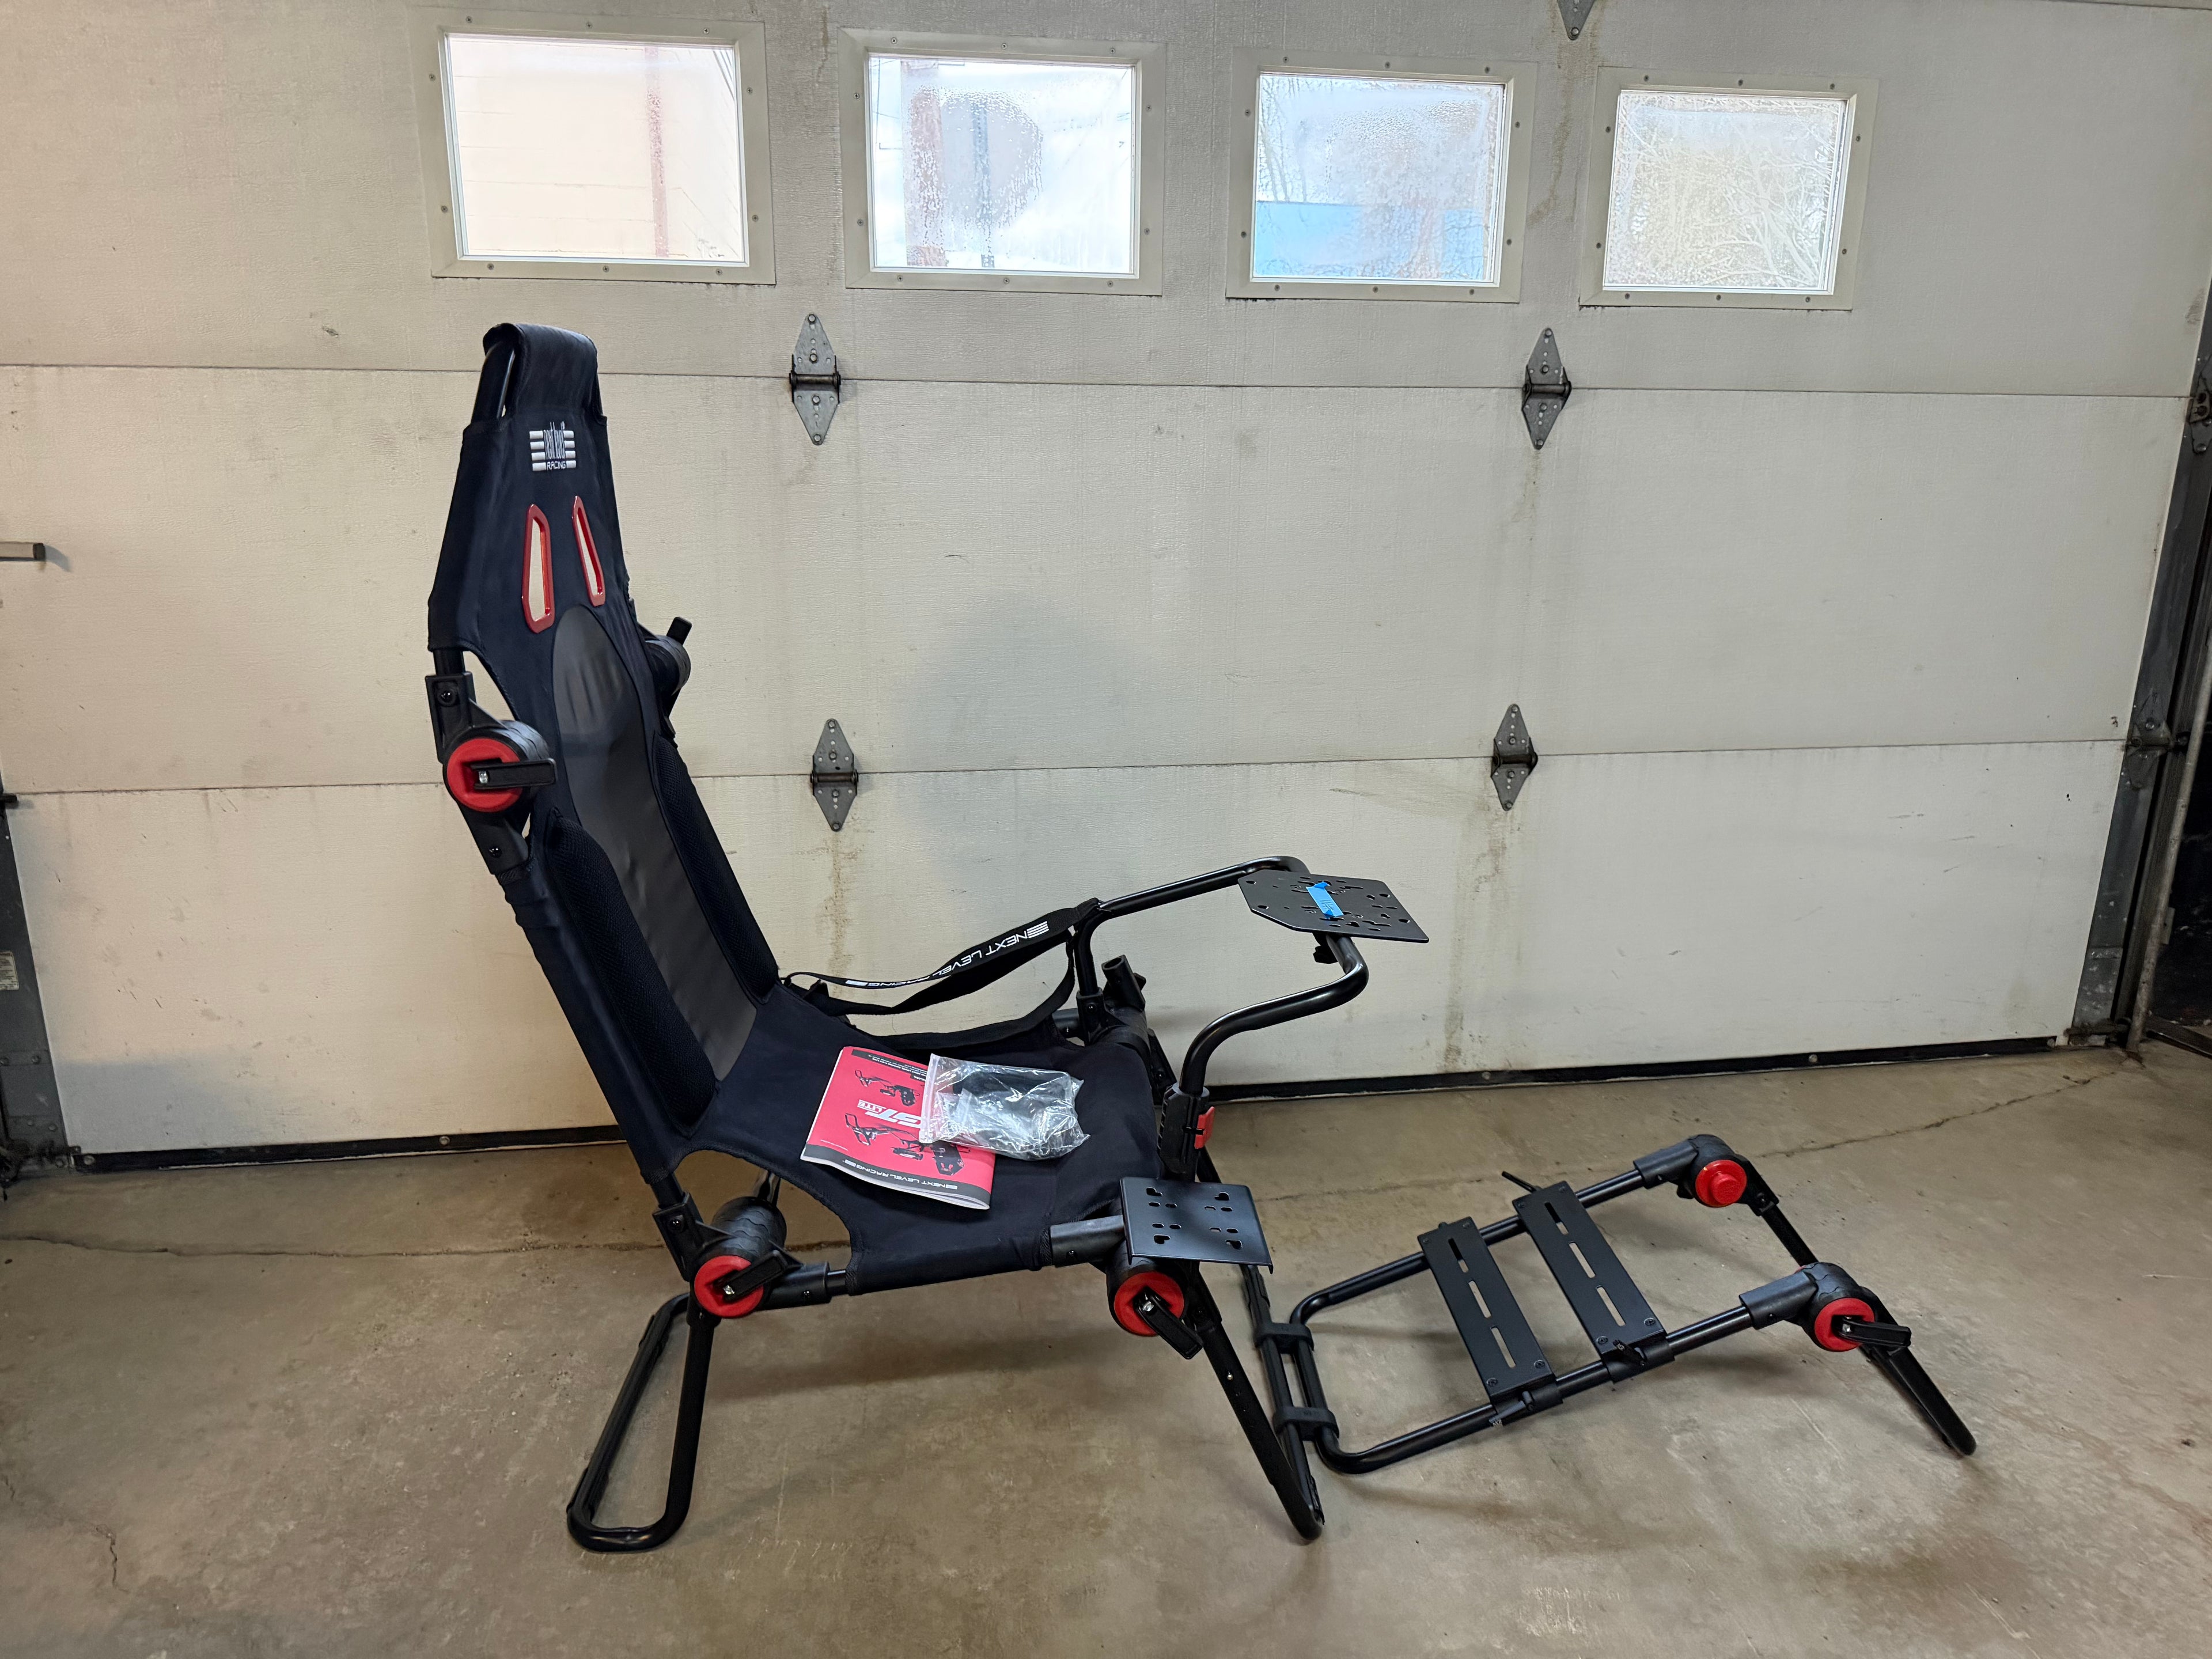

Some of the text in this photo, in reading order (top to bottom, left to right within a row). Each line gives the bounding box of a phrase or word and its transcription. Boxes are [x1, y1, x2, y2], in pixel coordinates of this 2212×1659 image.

[547, 461, 566, 470] RACING
[986, 930, 1028, 956] NEXT
[933, 950, 982, 976] LEVEL
[857, 1100, 883, 1113] LITE
[856, 1164, 889, 1177] RACING
[890, 1173, 919, 1183] LEVEL
